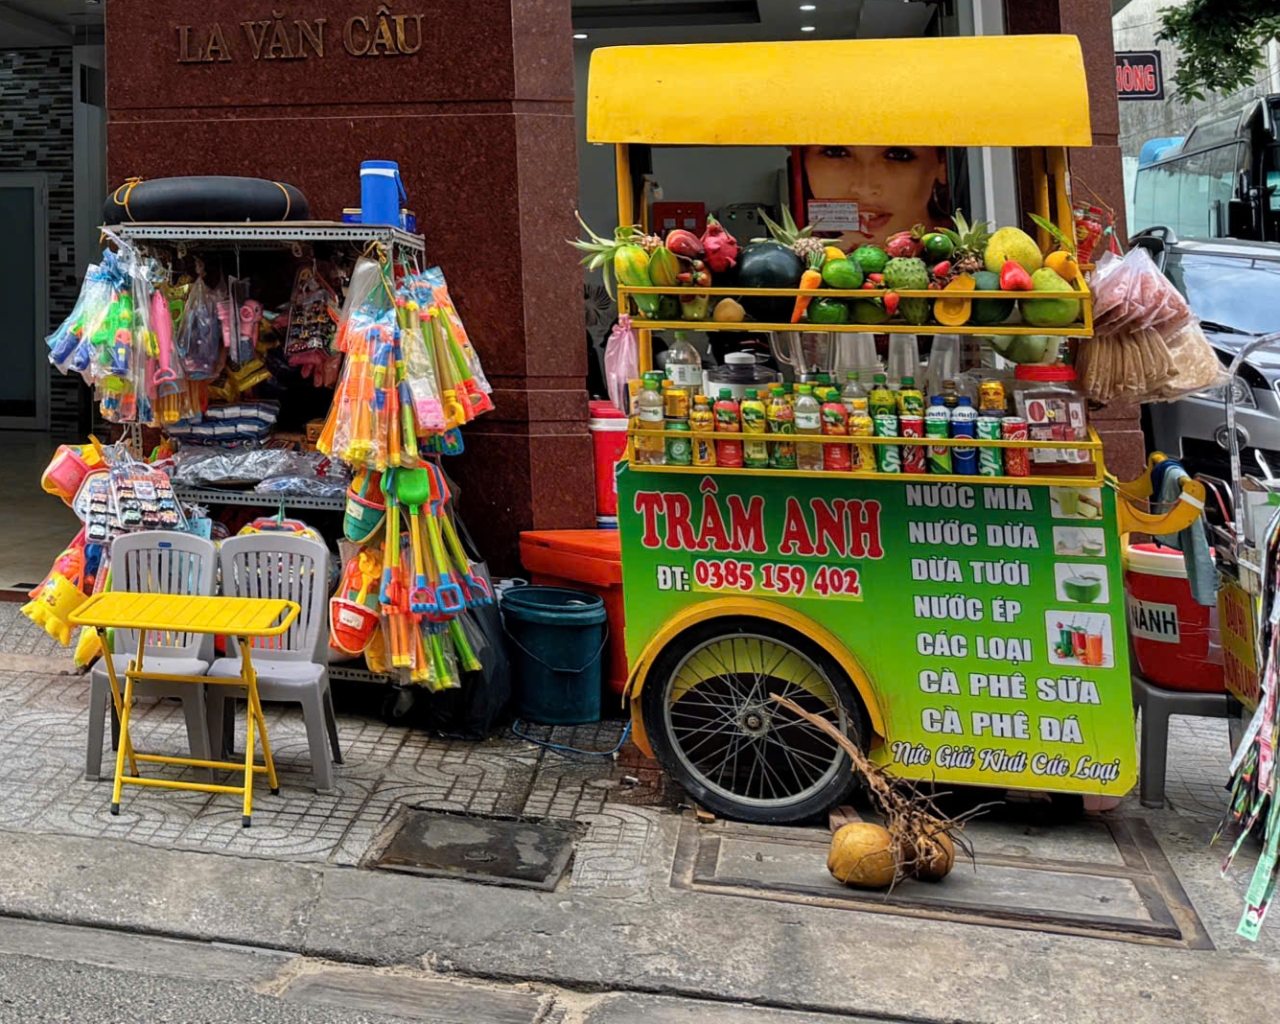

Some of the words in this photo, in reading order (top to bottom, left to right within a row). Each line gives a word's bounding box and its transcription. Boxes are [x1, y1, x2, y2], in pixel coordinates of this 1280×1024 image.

[176, 23, 233, 63] LA
[240, 9, 328, 60] VĂN
[983, 484, 1034, 511] MÍA
[634, 476, 768, 554] TRÂM
[778, 496, 885, 559] ANH
[908, 519, 978, 546] NƯỚC
[986, 522, 1040, 549] DỪA
[657, 564, 690, 592] ĐT:
[694, 559, 755, 592] 0385
[760, 563, 807, 596] 159
[814, 565, 861, 597] 402
[911, 556, 963, 583] DỪA
[969, 559, 1031, 586] TƯƠI
[914, 594, 984, 621] NƯỚC
[991, 596, 1022, 623] ÉP
[916, 630, 968, 658] CÁC
[975, 635, 1033, 665] LOẠI
[918, 667, 961, 695] CÀ
[969, 671, 1028, 700] PHÊ
[1036, 675, 1101, 705] SỮA
[921, 705, 964, 735] CÀ
[971, 710, 1031, 740] PHÊ
[1039, 714, 1083, 744] ĐÁ
[1072, 755, 1121, 785] Loại
